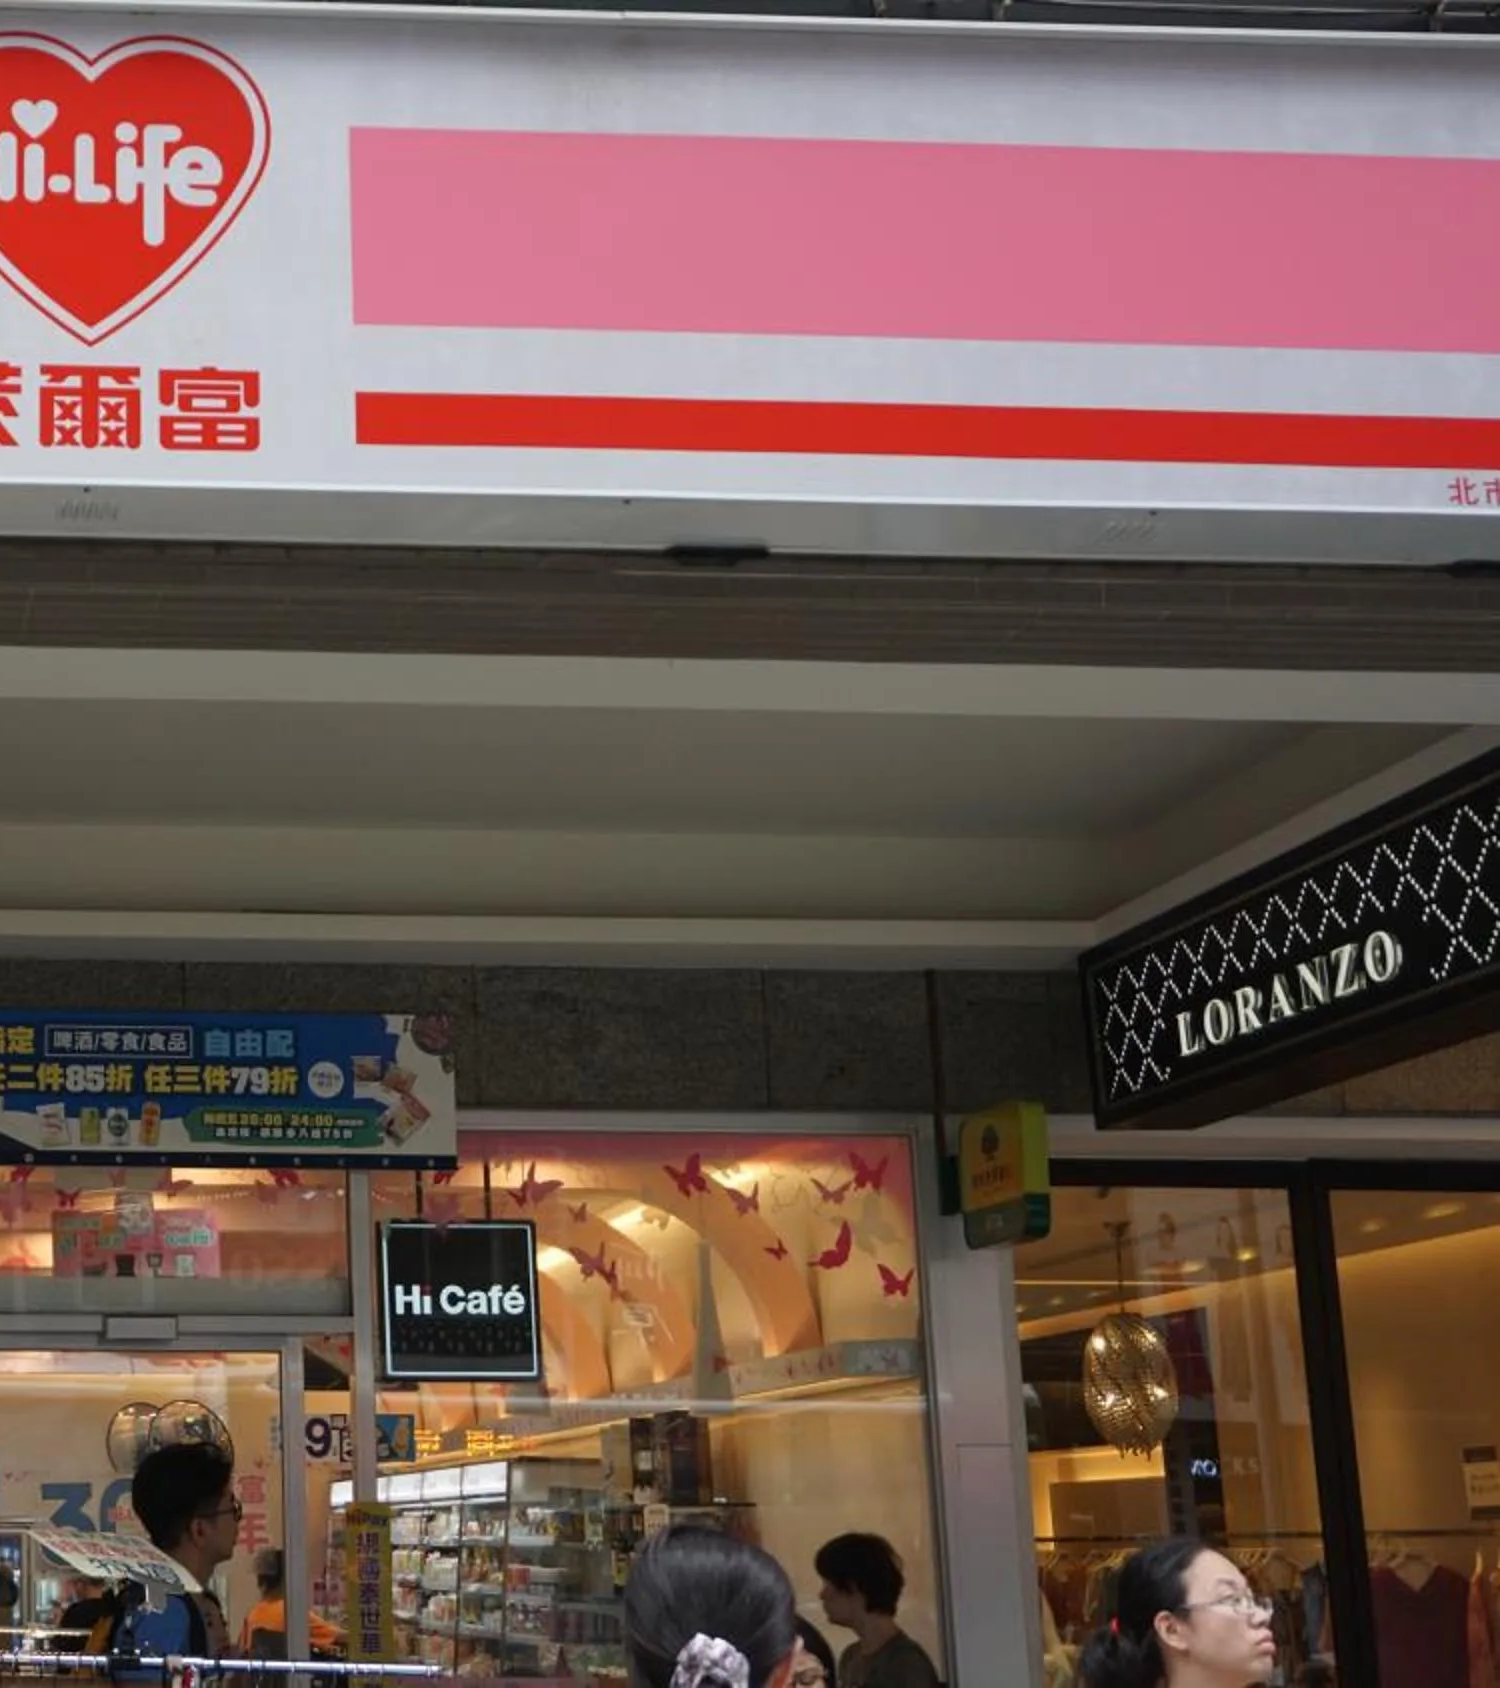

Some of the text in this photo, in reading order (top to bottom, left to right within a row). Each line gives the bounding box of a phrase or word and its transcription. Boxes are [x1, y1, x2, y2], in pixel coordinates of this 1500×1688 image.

[1175, 929, 1404, 1058] LORANZO
[203, 1027, 296, 1058] 自由配
[144, 1064, 298, 1095] 任三件79折
[393, 1283, 526, 1316] Hi Café
